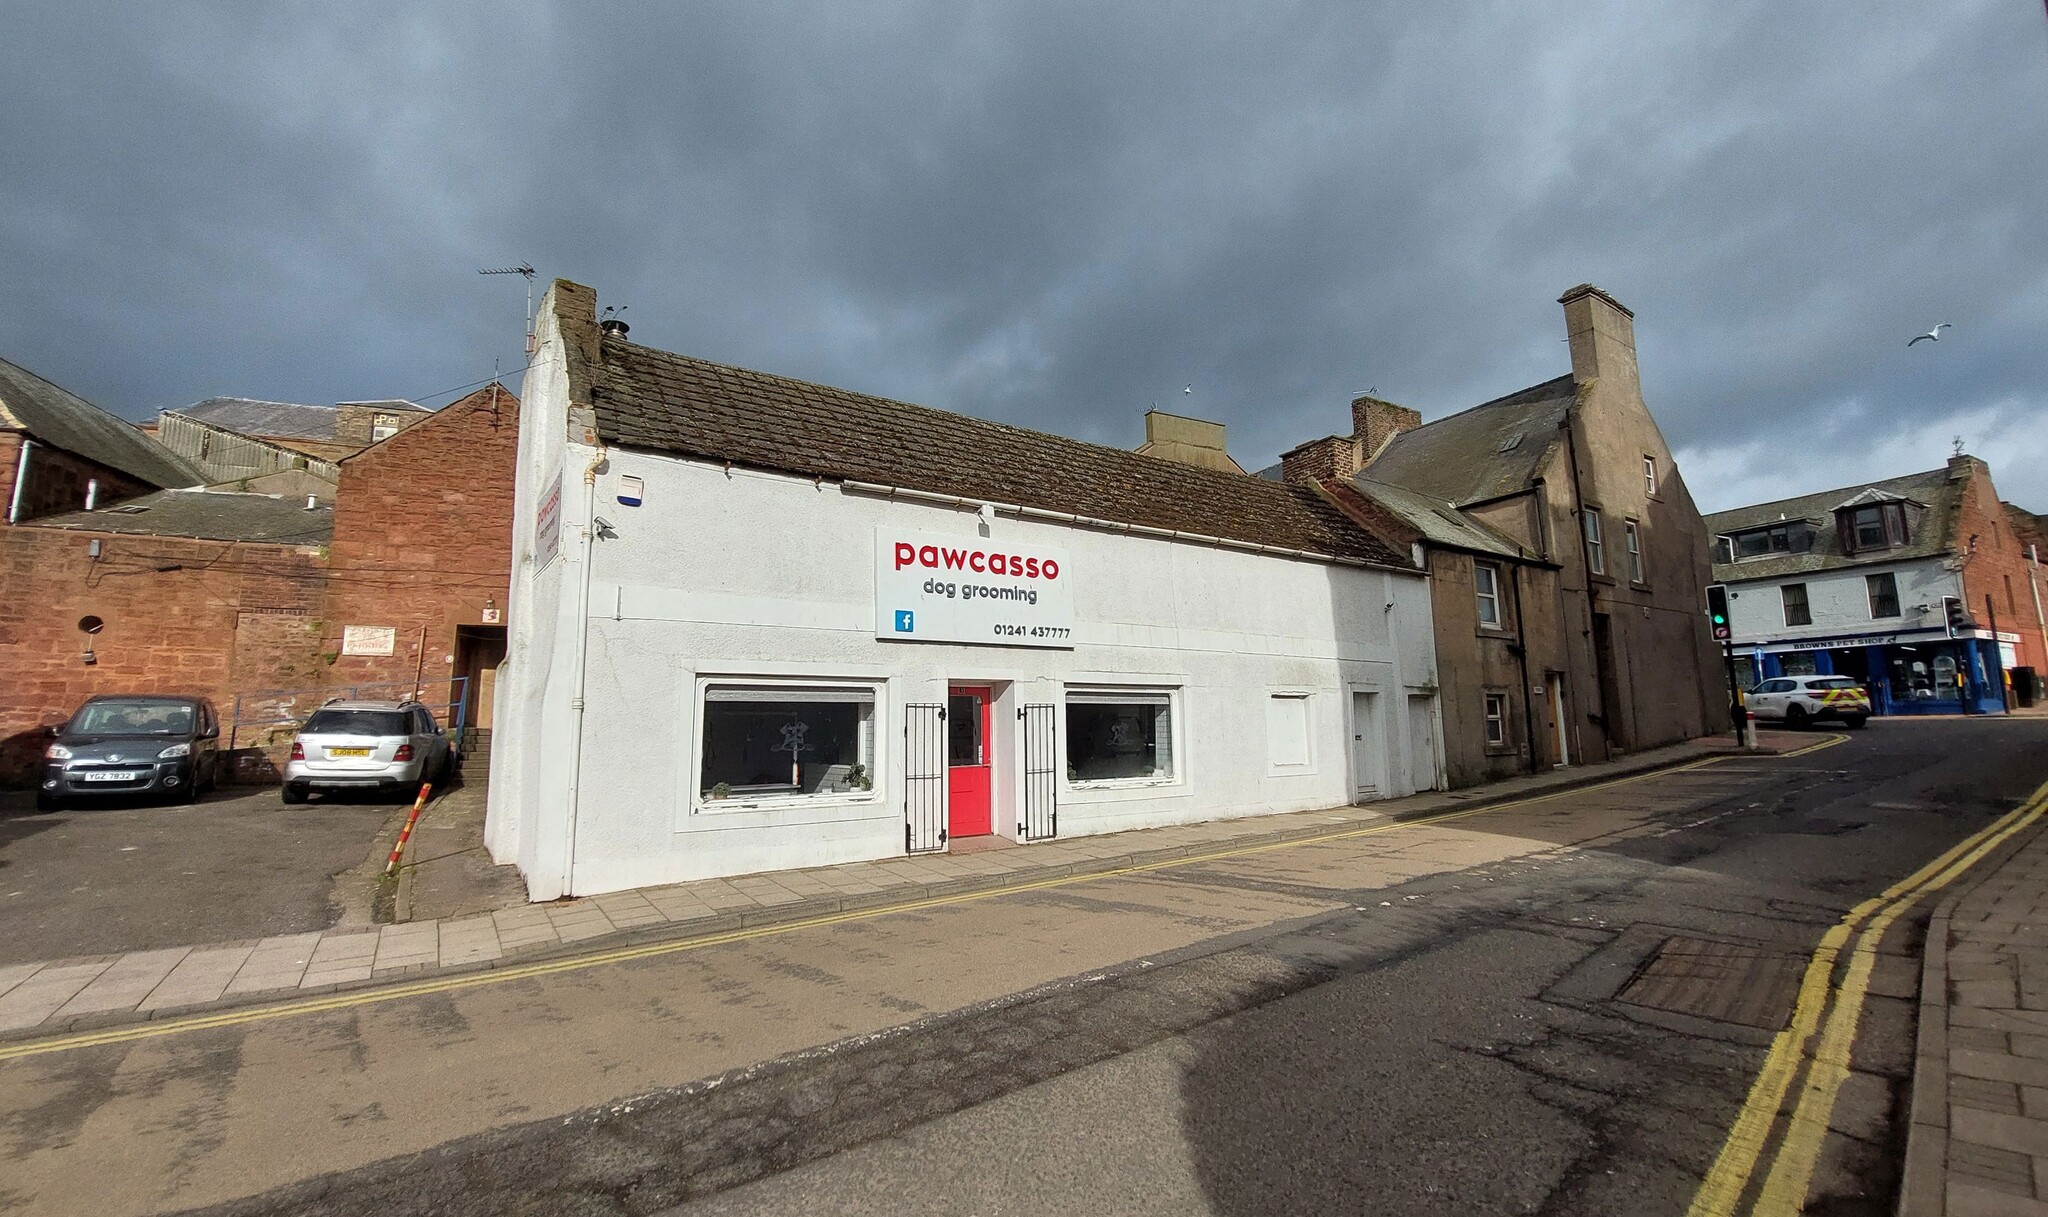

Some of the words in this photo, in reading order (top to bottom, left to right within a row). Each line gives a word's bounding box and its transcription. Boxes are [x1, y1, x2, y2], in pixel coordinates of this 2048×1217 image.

[895, 542, 1059, 580] pawcasso
[923, 578, 956, 599] dog
[961, 584, 1037, 605] grooming
[993, 624, 1026, 637] 01241
[1030, 626, 1071, 639] 437777
[1793, 641, 1834, 650] BROWNS
[1836, 639, 1855, 647] PET
[1857, 637, 1884, 645] SHOP
[109, 772, 131, 780] 7832
